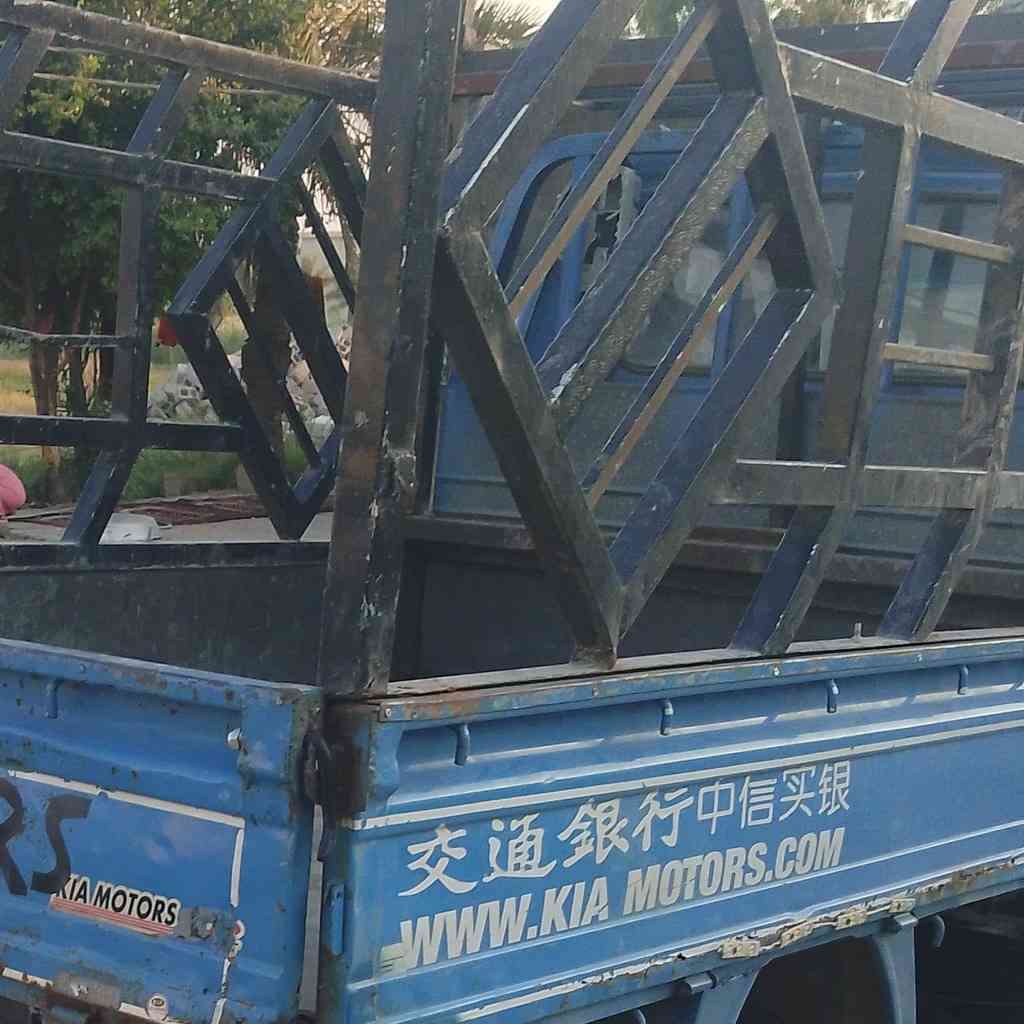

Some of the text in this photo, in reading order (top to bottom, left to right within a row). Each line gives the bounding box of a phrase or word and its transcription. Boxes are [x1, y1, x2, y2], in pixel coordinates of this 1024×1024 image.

[93, 881, 178, 926] MOTORS
[399, 827, 846, 971] WWW.KIA MOTORS.COM
